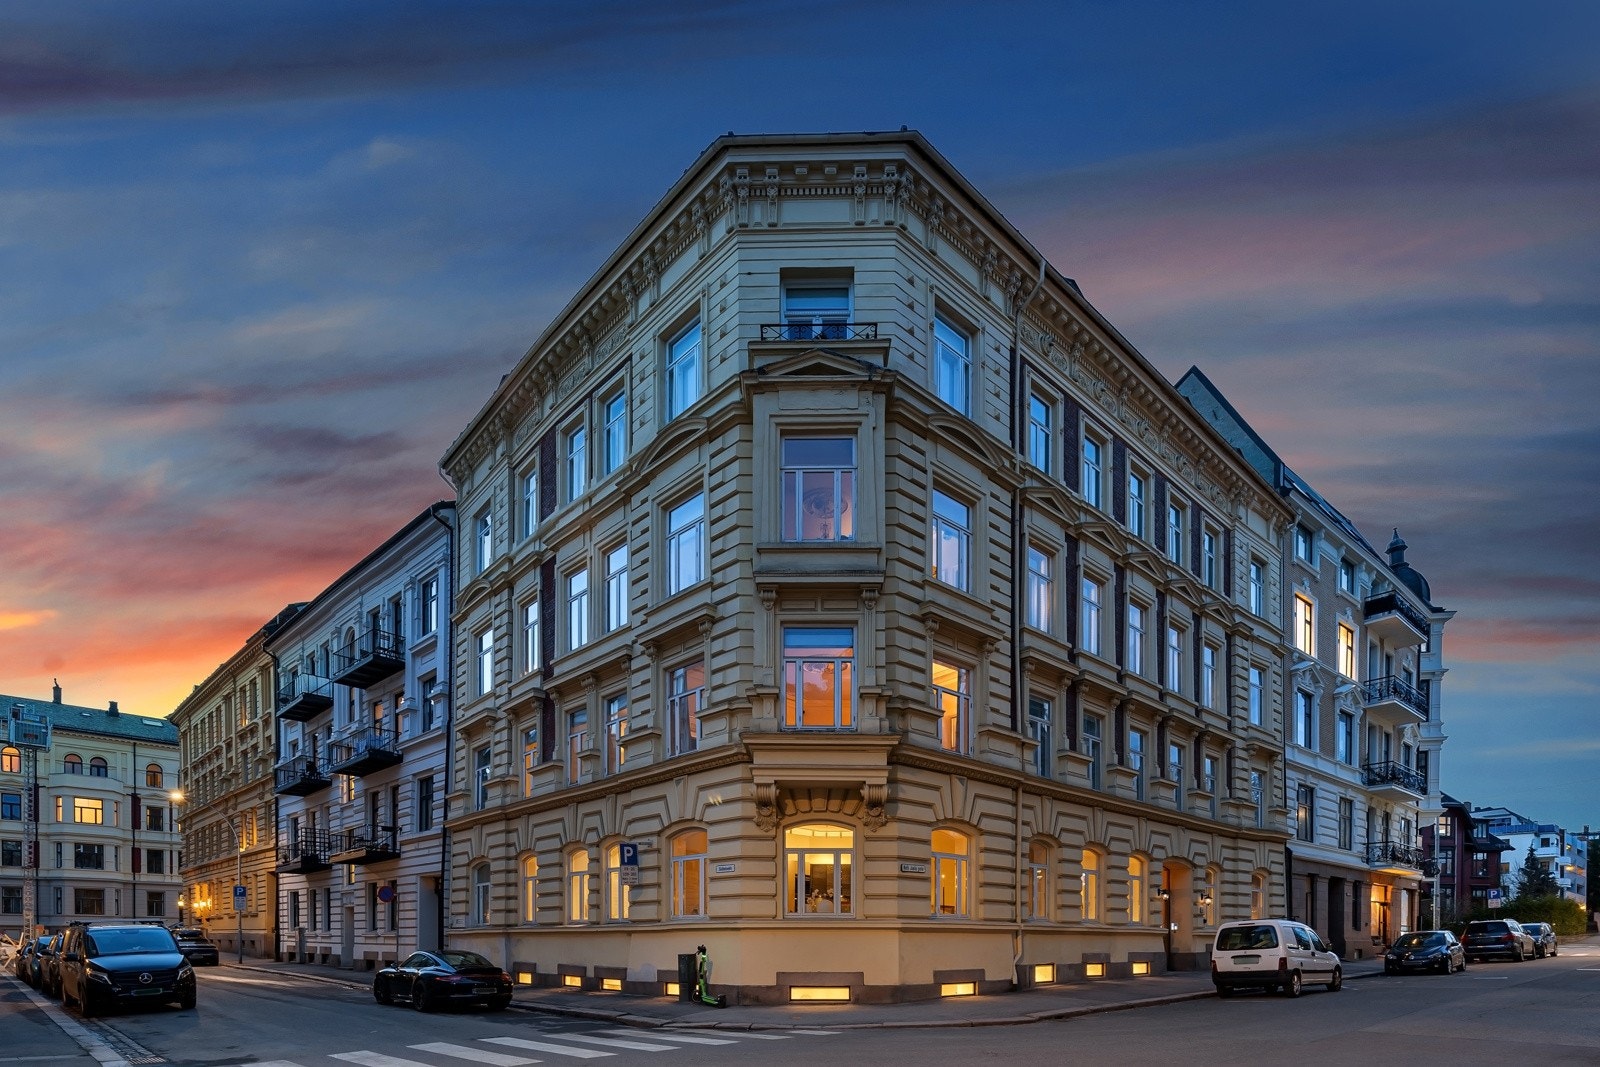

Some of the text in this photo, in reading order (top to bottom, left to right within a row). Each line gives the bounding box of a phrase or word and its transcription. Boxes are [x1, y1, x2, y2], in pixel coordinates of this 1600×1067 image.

[623, 846, 633, 863] P
[236, 887, 243, 895] P
[1490, 890, 1497, 898] P
